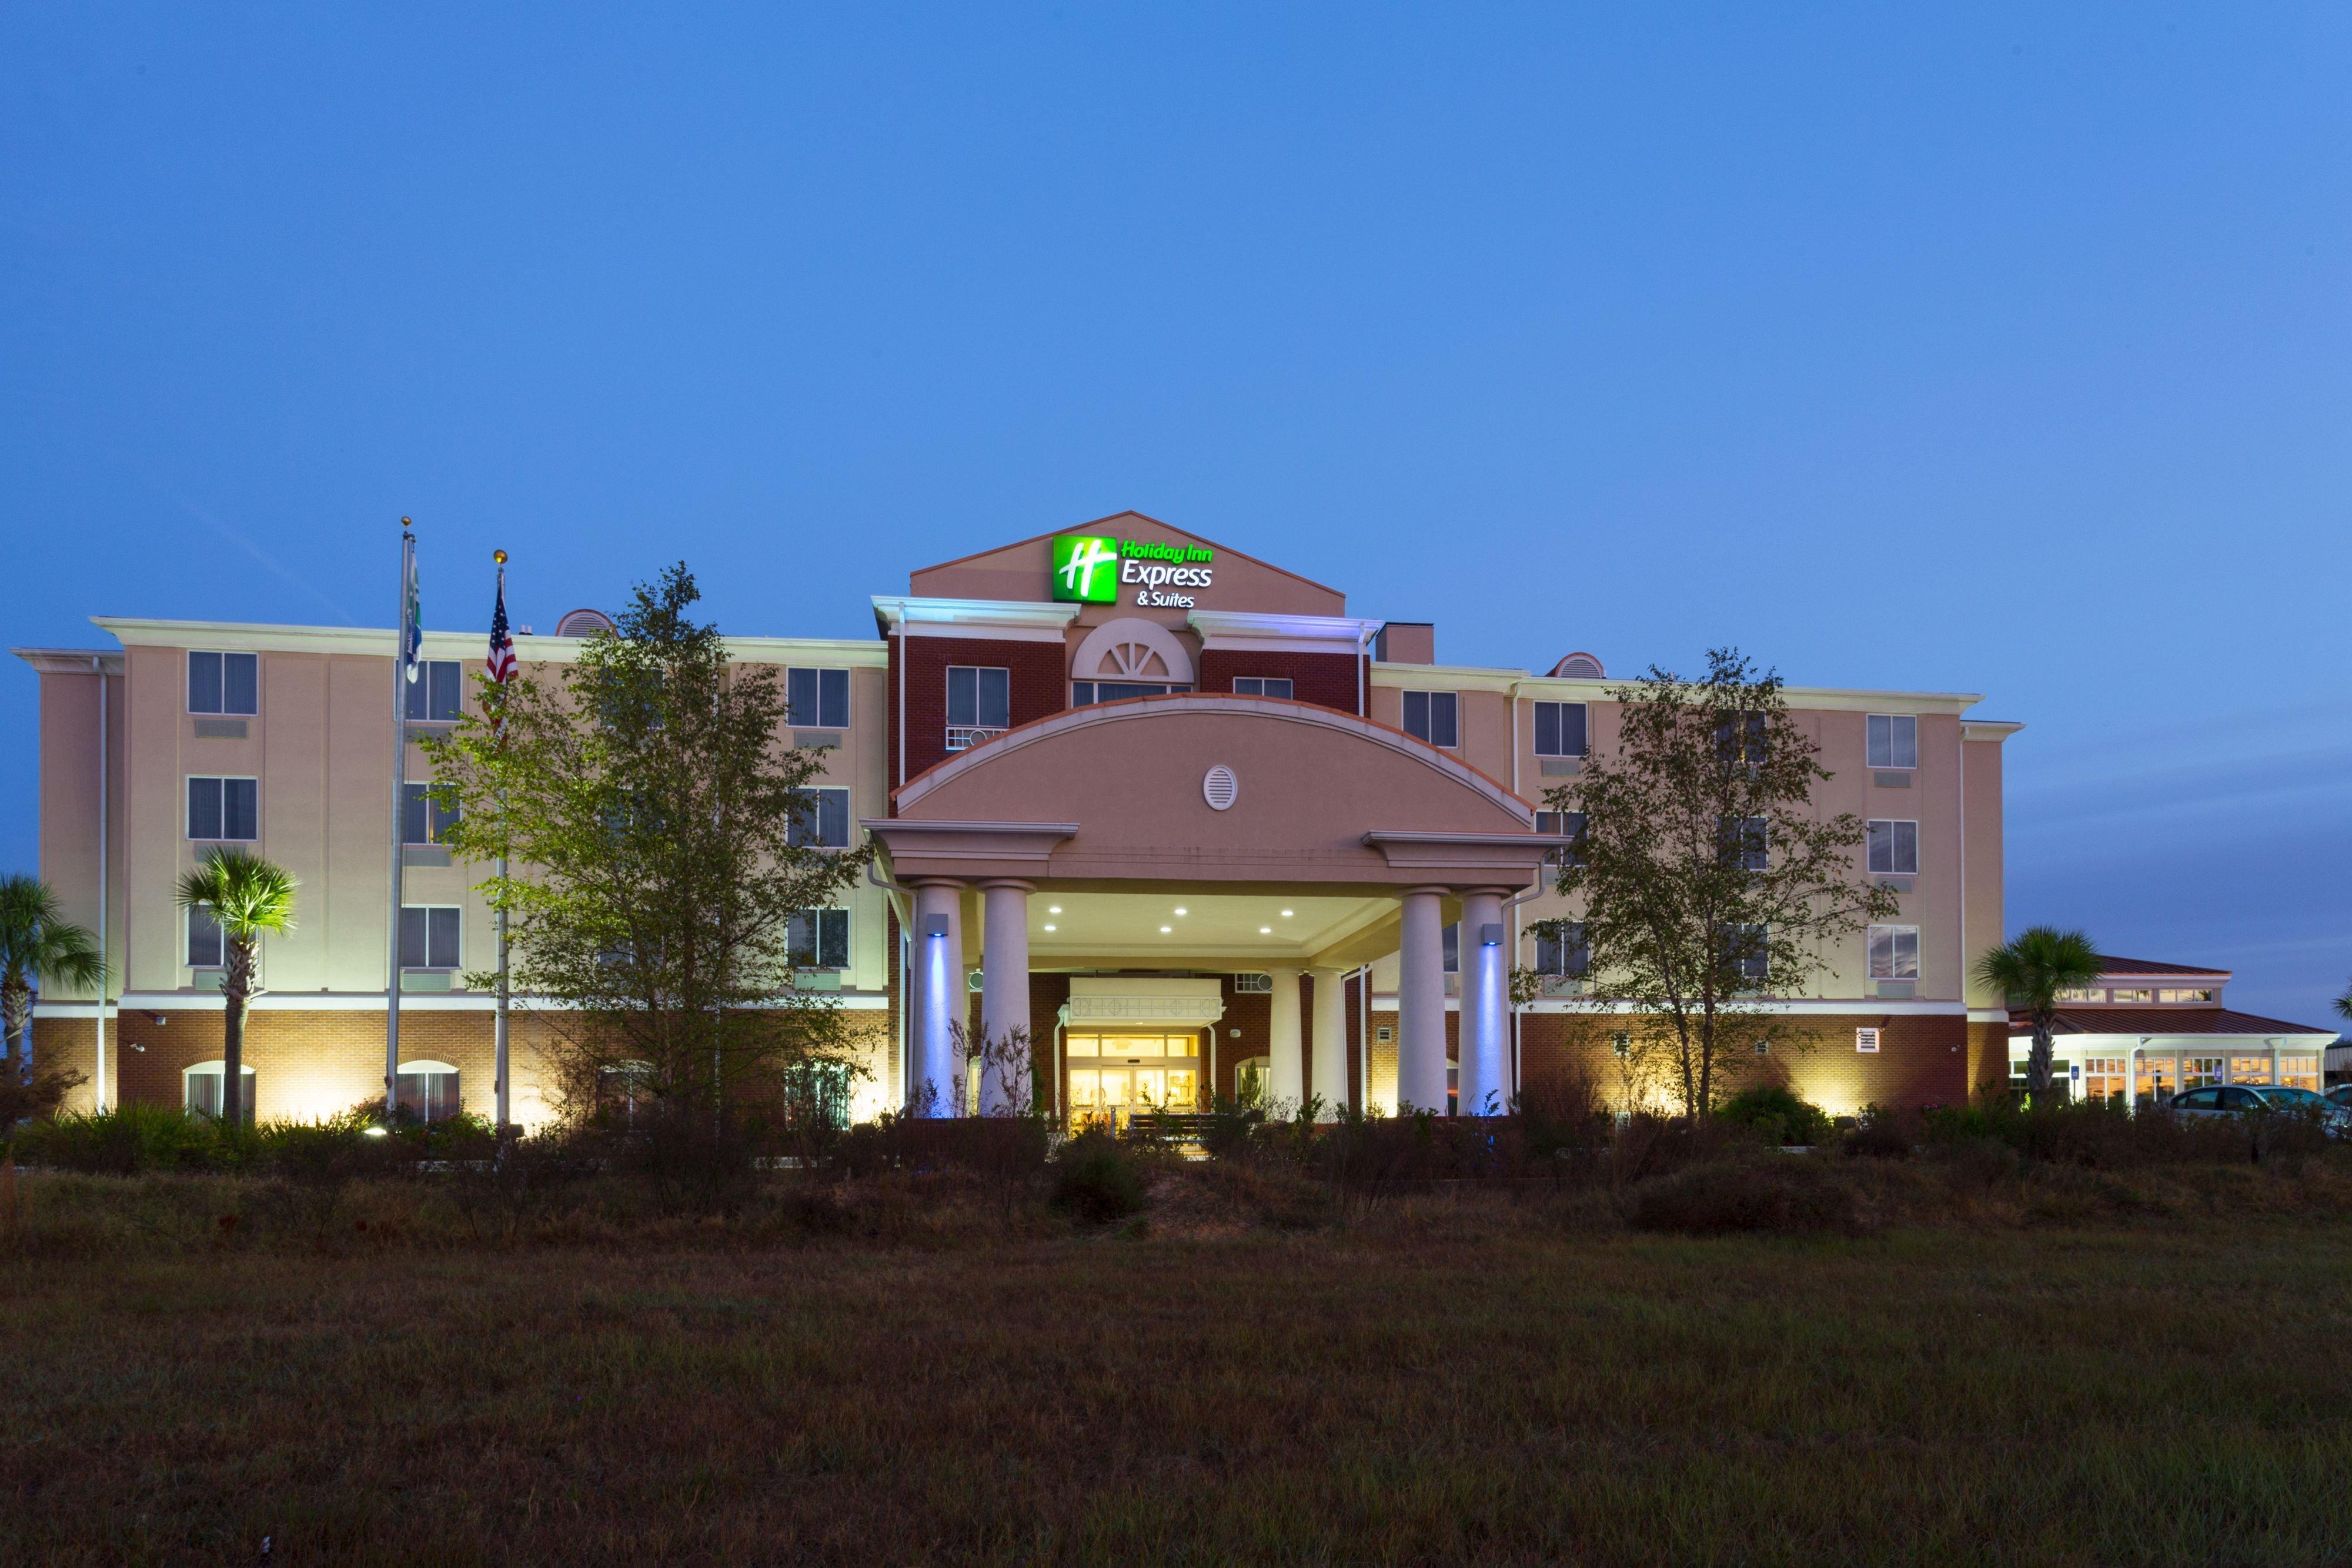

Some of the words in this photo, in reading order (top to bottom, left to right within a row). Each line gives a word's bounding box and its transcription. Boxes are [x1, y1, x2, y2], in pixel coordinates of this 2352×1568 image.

[1121, 540, 1185, 564] Holiday
[1187, 543, 1213, 562] Inn
[1122, 559, 1212, 590] Express
[1137, 591, 1148, 606] &
[1151, 591, 1194, 608] Suites
